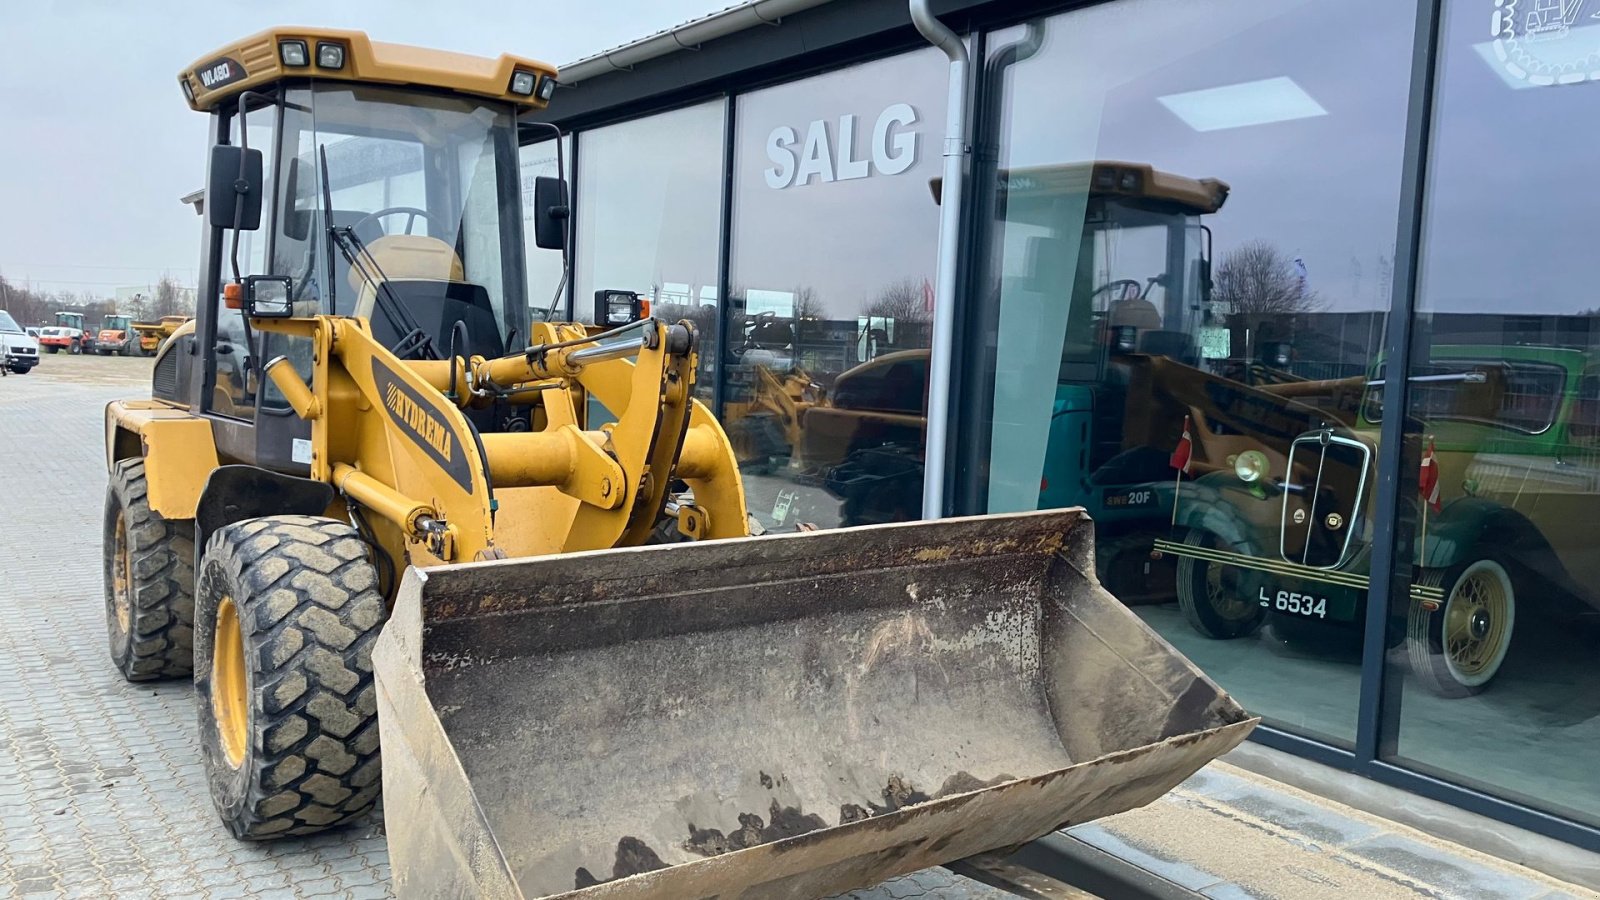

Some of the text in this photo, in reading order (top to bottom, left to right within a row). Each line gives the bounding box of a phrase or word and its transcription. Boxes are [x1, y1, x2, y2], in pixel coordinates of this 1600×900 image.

[764, 103, 917, 189] SALG
[394, 387, 451, 463] HYDREMA
[1275, 590, 1327, 619] 6534
